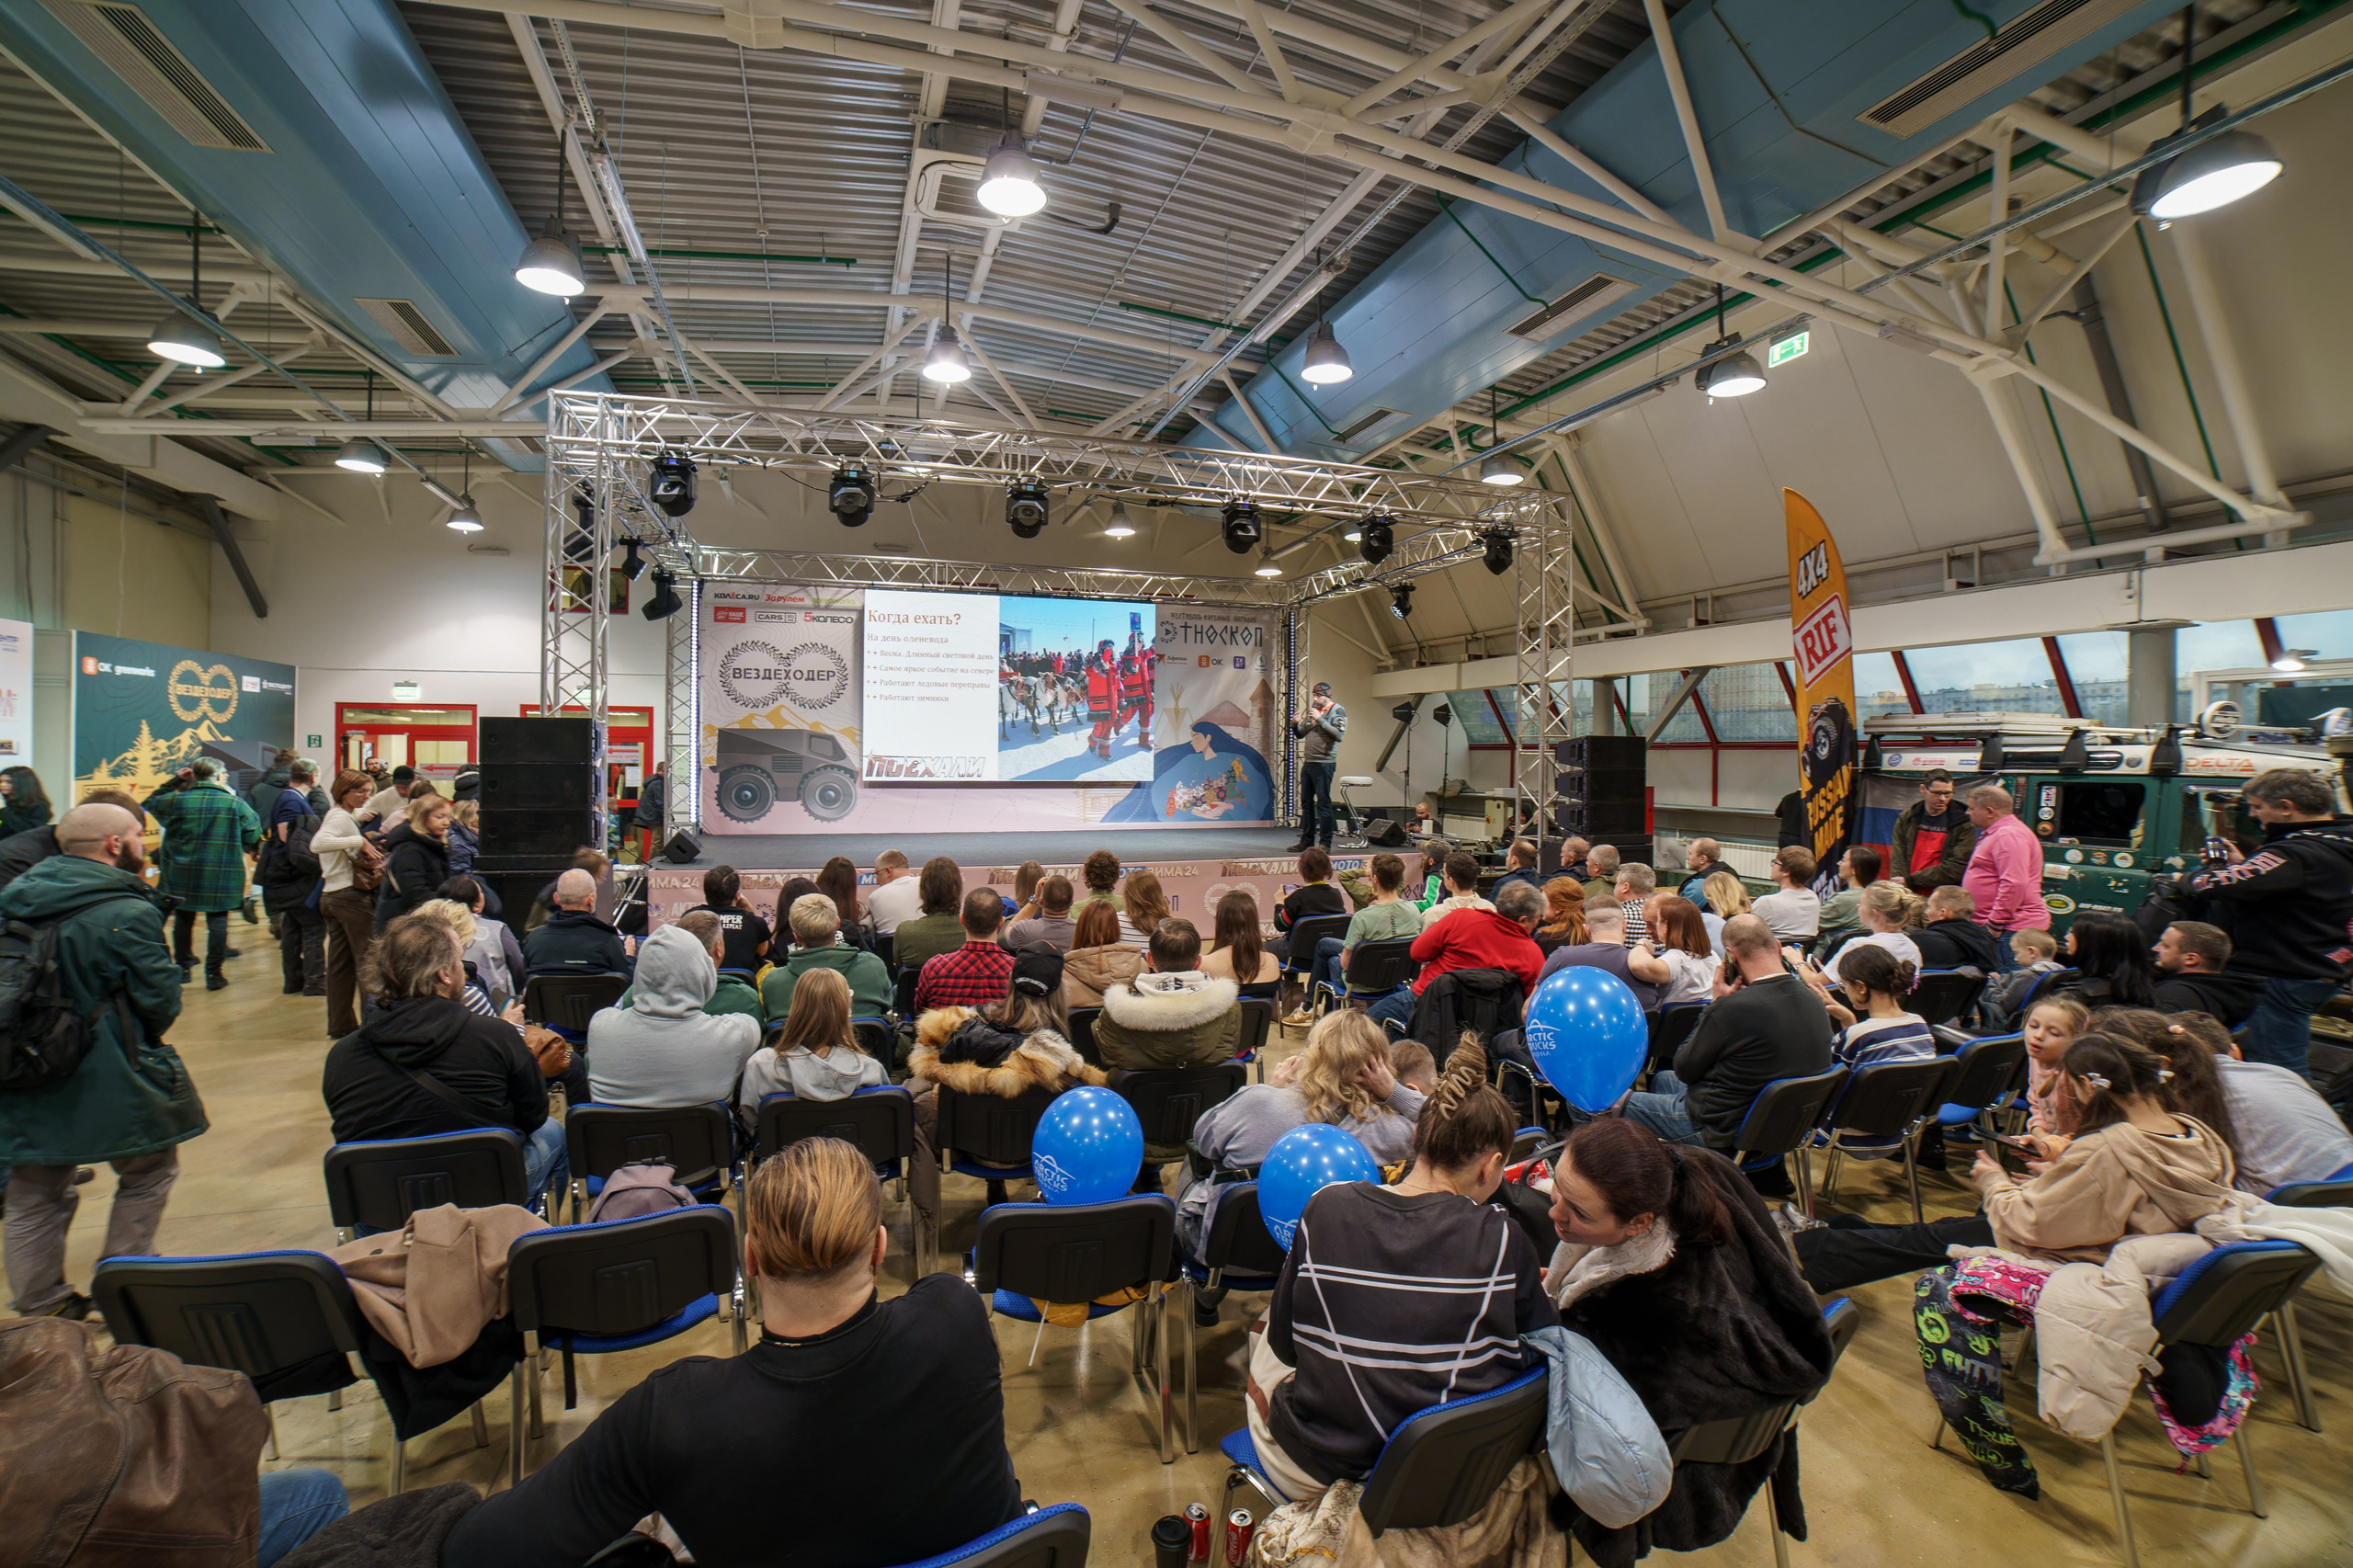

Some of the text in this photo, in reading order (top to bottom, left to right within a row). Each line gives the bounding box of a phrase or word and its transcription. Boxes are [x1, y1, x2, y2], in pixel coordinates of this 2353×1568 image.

[868, 609, 961, 626] Когда ехать?
[867, 633, 879, 642] На
[904, 635, 949, 643] оленевода
[1802, 609, 1838, 674] RIF
[905, 650, 940, 659] Длинный
[942, 652, 975, 660] световой
[732, 667, 836, 682] ВЕЗДЕХОДЕР
[904, 665, 926, 674] яркое
[927, 665, 959, 674] событие
[971, 668, 995, 676] севере
[880, 679, 915, 687] Работают
[950, 682, 991, 690] переправы
[1814, 805, 1845, 863] MADE
[1184, 866, 1199, 876] 24
[681, 876, 699, 888] 24
[1034, 1159, 1068, 1186] ARCTIC
